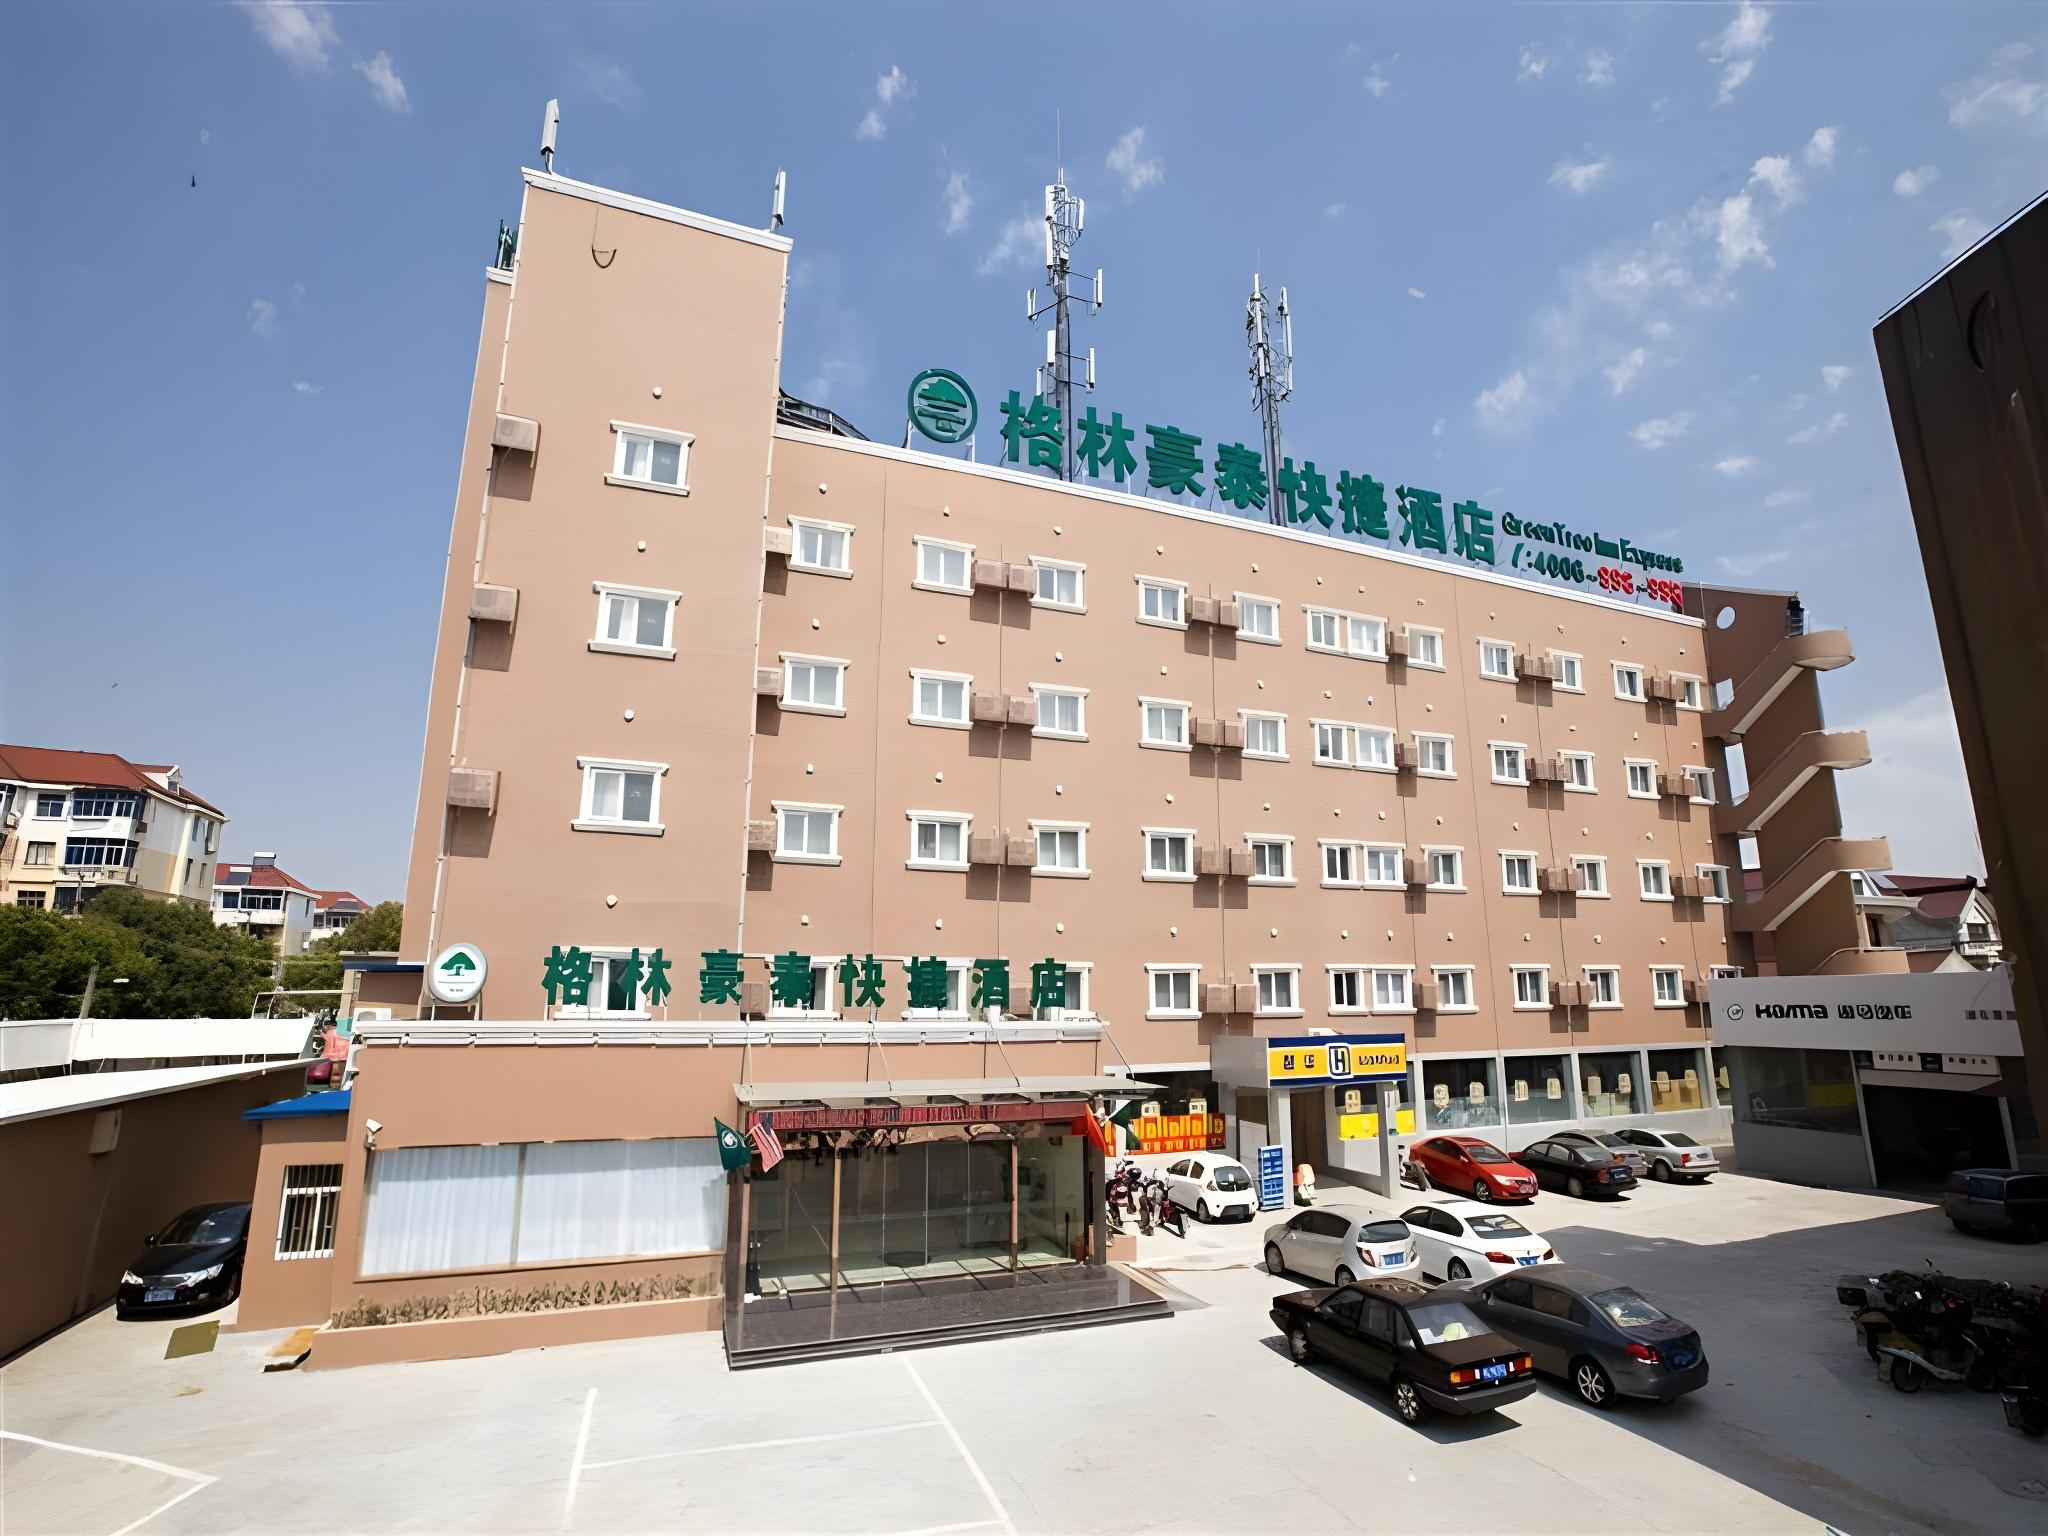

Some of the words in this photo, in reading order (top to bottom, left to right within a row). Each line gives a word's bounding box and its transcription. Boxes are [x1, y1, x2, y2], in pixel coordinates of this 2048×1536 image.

[1000, 389, 1496, 566] 格林豪泰快捷酒店
[541, 945, 1067, 1010] 格林豪泰快捷酒店
